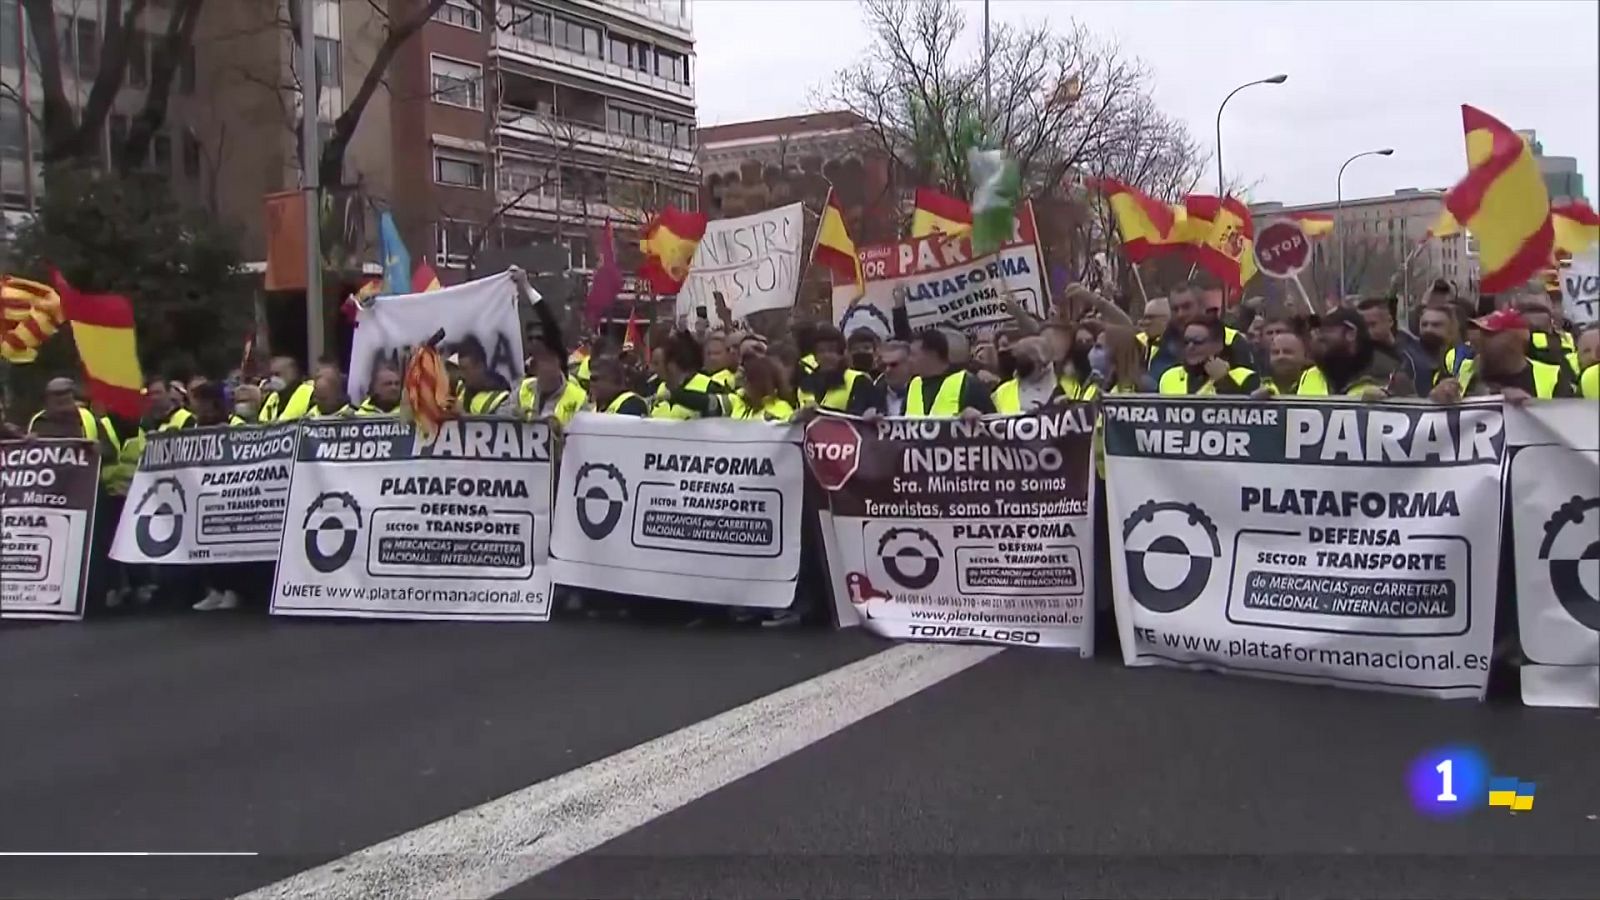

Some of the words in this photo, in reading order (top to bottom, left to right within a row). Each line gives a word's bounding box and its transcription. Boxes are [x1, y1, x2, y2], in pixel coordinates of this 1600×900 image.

[1261, 234, 1301, 261] STOP
[906, 256, 1031, 302] LATAFORMA
[938, 287, 998, 315] DEFENSA
[877, 420, 941, 440] PARO
[950, 407, 1093, 441] NACIONAL
[1104, 405, 1159, 424] PARA
[1165, 407, 1195, 424] NO
[1202, 408, 1277, 425] GANAR
[1285, 407, 1503, 463] PARAR
[231, 436, 293, 461] VENCIDO
[303, 426, 337, 438] PARA
[341, 426, 360, 438] NO
[363, 424, 410, 438] GANAR
[411, 419, 549, 460] PARAR
[316, 441, 393, 459] MEJOR
[1135, 429, 1251, 457] MEJOR
[807, 442, 855, 461] STOP
[903, 446, 1063, 473] INDEFINIDO
[644, 453, 775, 477] PLATAFORMA
[201, 465, 290, 487] PLATAFORMA
[680, 479, 735, 494] DEFENSA
[893, 477, 922, 493] Sra.
[928, 475, 990, 493] Ministra
[995, 481, 1016, 492] no
[1021, 477, 1066, 492] somos
[23, 491, 67, 505] Marzo
[221, 486, 261, 498] DEFENSA
[380, 477, 529, 499] PLATAFORMA
[421, 503, 488, 517] DEFENSA
[682, 496, 767, 513] TRANSPORTE
[949, 502, 991, 516] somo
[1241, 486, 1460, 519] PLATAFORMA
[386, 522, 420, 532] SECTOR
[426, 520, 521, 535] TRANSPORTE
[645, 525, 686, 537] NACIONAL
[692, 529, 768, 543] INTERNACIONAL
[718, 518, 768, 530] CARRETERA
[953, 523, 1076, 539] PLATAFORMA
[1308, 526, 1401, 546] DEFENSA
[998, 543, 1043, 552] DEFENSA
[382, 551, 430, 563] NACIONAL
[440, 553, 522, 566] INTERNACIONAL
[1257, 552, 1307, 568] SECTOR
[1316, 551, 1447, 572] TRANSPORTE
[281, 583, 322, 598] ÚNETE
[326, 584, 544, 605] www.plataformanacional.es
[1252, 574, 1267, 588] de
[1268, 576, 1349, 594] MERCANCIAS
[1350, 584, 1371, 597] por
[1373, 582, 1449, 597] CARRETERA
[1250, 593, 1320, 611] NACIONAL
[1331, 598, 1449, 616] INTERNACIONAL
[908, 624, 1041, 644] TOMELLOSO
[1163, 632, 1489, 672] www.plataformanacional.es
